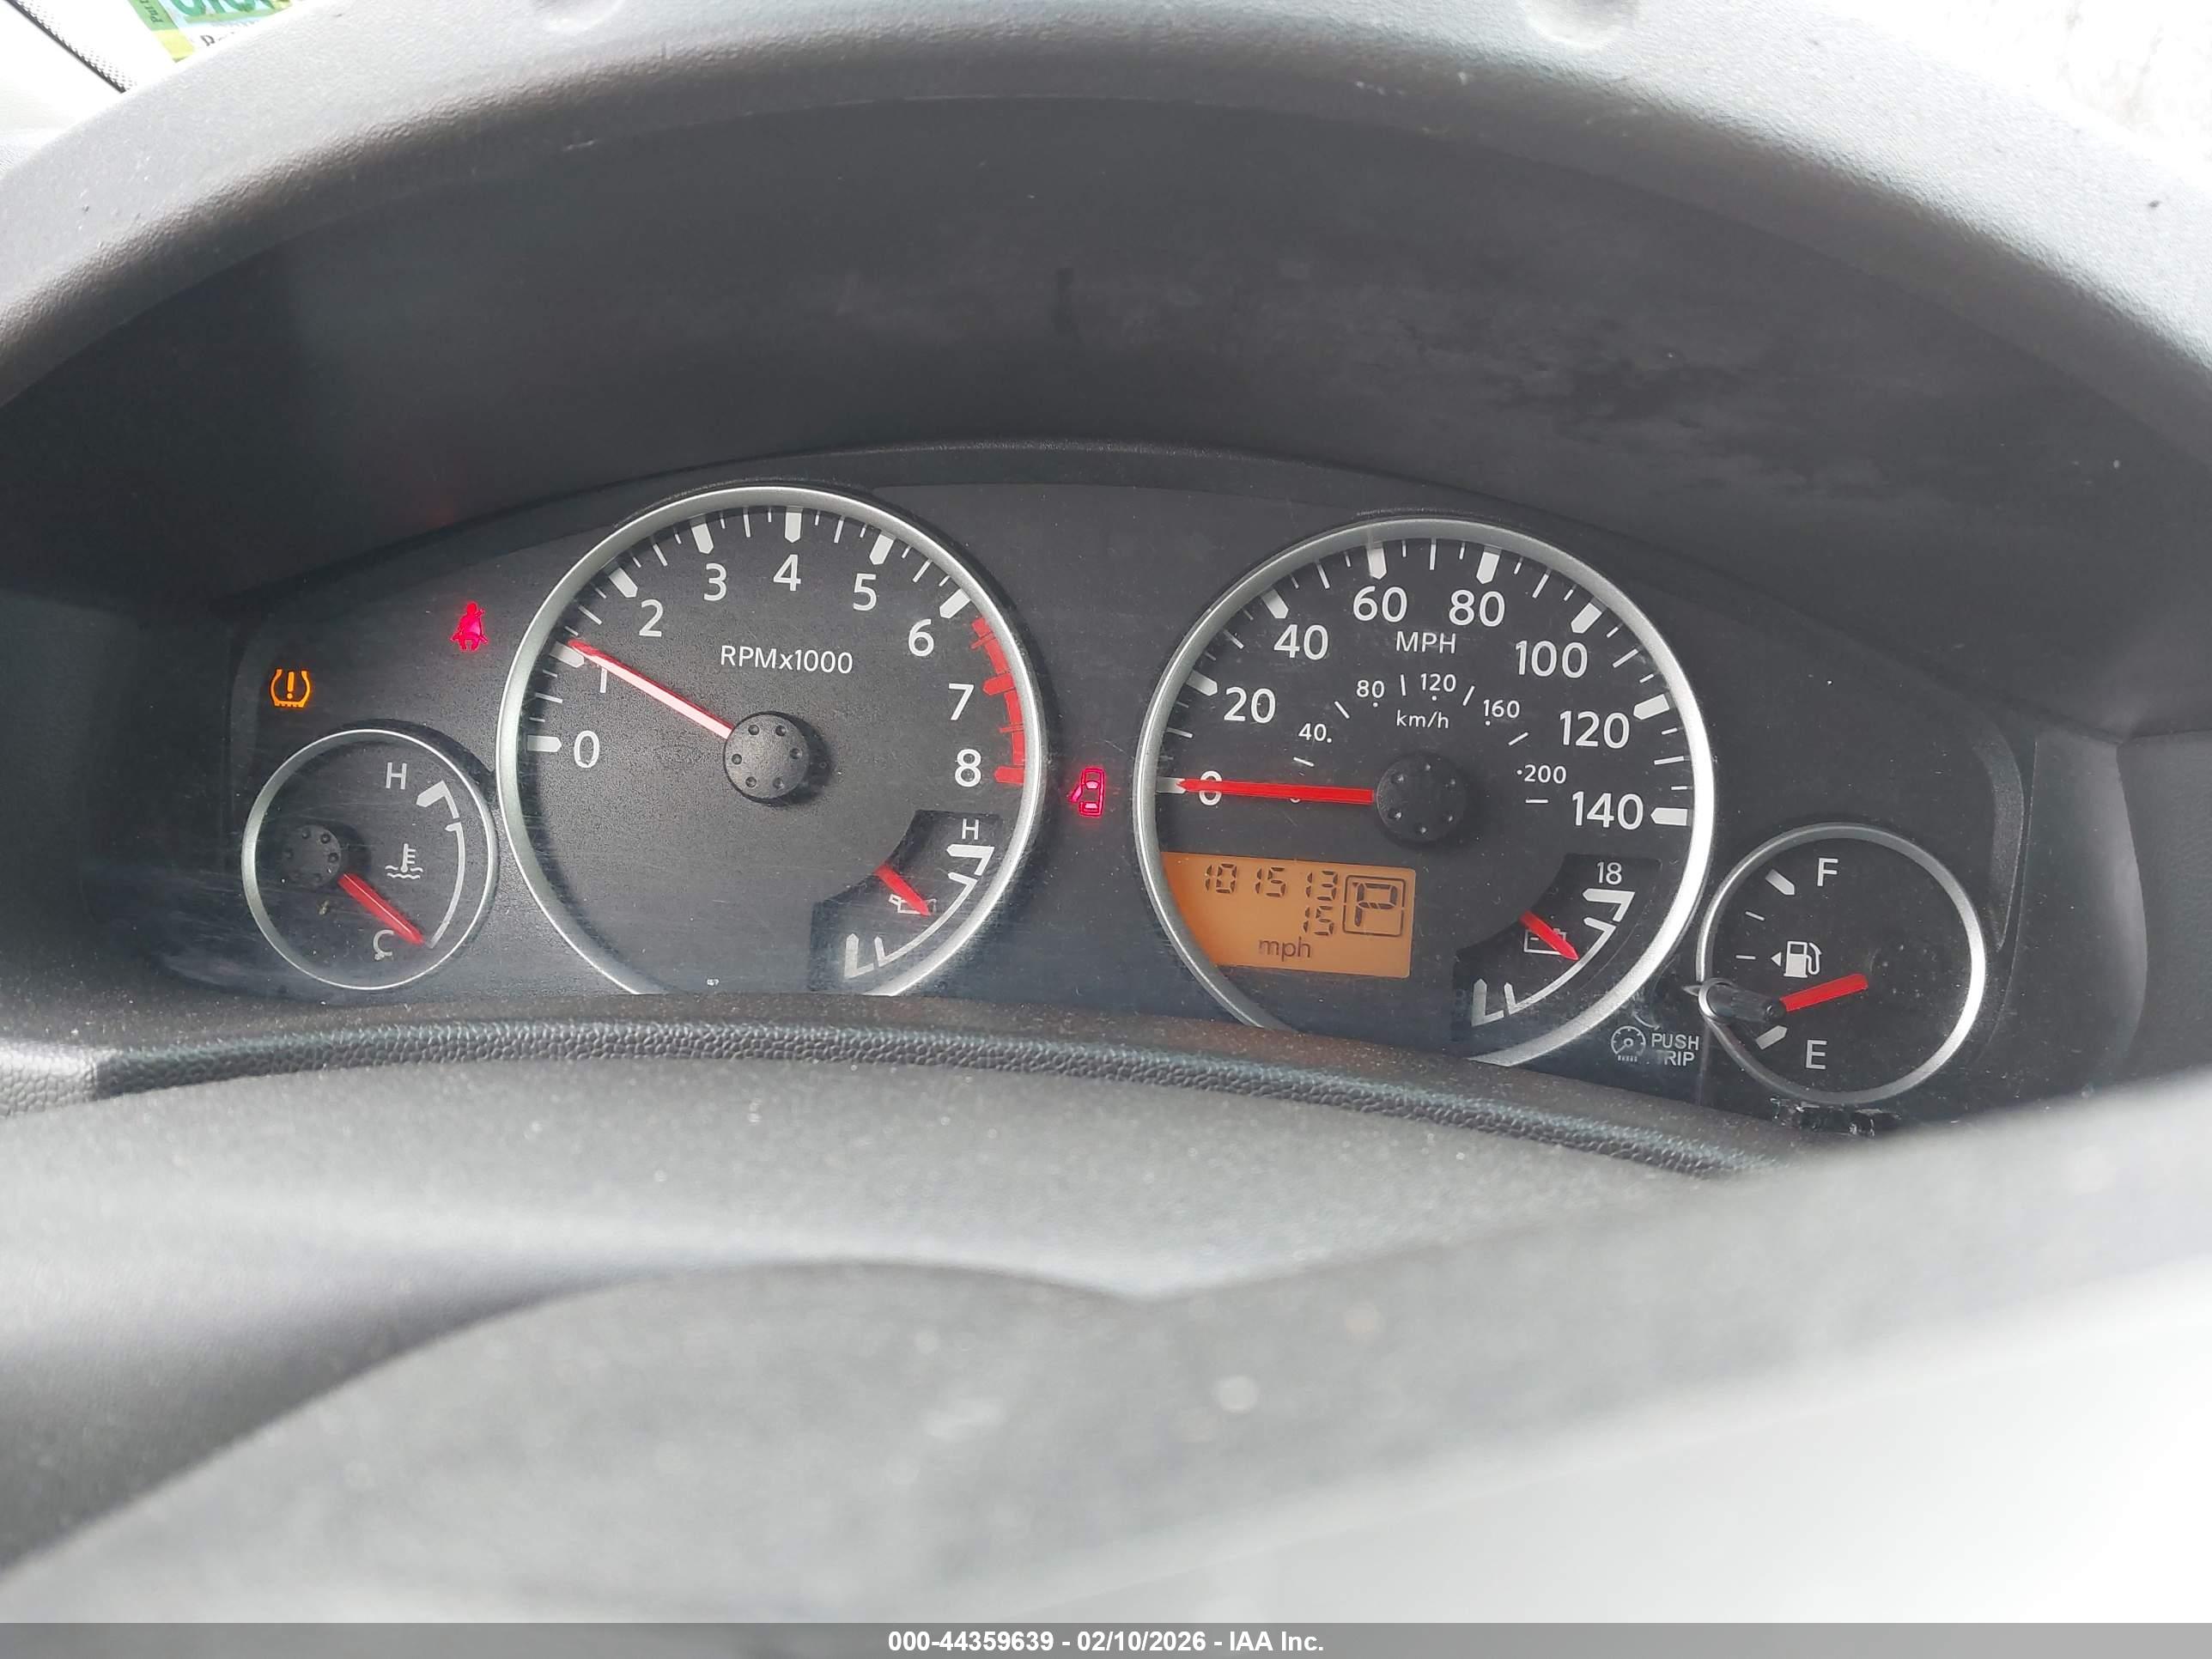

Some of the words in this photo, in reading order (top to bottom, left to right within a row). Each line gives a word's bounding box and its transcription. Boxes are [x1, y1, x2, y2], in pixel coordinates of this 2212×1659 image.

[704, 563, 726, 601] 3
[774, 555, 801, 591] 4
[854, 574, 876, 611] 5
[1353, 586, 1407, 622] 60
[1449, 590, 1504, 626] 80
[639, 599, 663, 636] 2
[908, 619, 933, 656] 6
[1274, 624, 1328, 659] 40
[1396, 631, 1455, 653] MPH
[721, 646, 852, 673] RPMx1000
[1516, 641, 1587, 678] 100
[1357, 680, 1384, 698] 80
[1421, 673, 1455, 691] 120
[949, 684, 974, 720] 7
[1224, 687, 1275, 723] 20
[1397, 710, 1448, 728] km/h
[1484, 700, 1519, 718] 160
[1298, 724, 1326, 741] 40
[1560, 711, 1629, 748] 120
[574, 731, 599, 768] 0
[386, 763, 407, 789] H
[955, 749, 981, 787] 8
[1525, 764, 1566, 783] 200
[1573, 792, 1643, 830] 140
[962, 819, 979, 840] H
[1205, 863, 1339, 902] 101513
[1598, 862, 1621, 884] 18
[1818, 858, 1838, 886] F
[1303, 905, 1334, 936] 15
[1352, 882, 1398, 927] P
[1259, 936, 1311, 962] mph
[1651, 1033, 1699, 1050] PUSH
[1806, 1040, 1826, 1069] E
